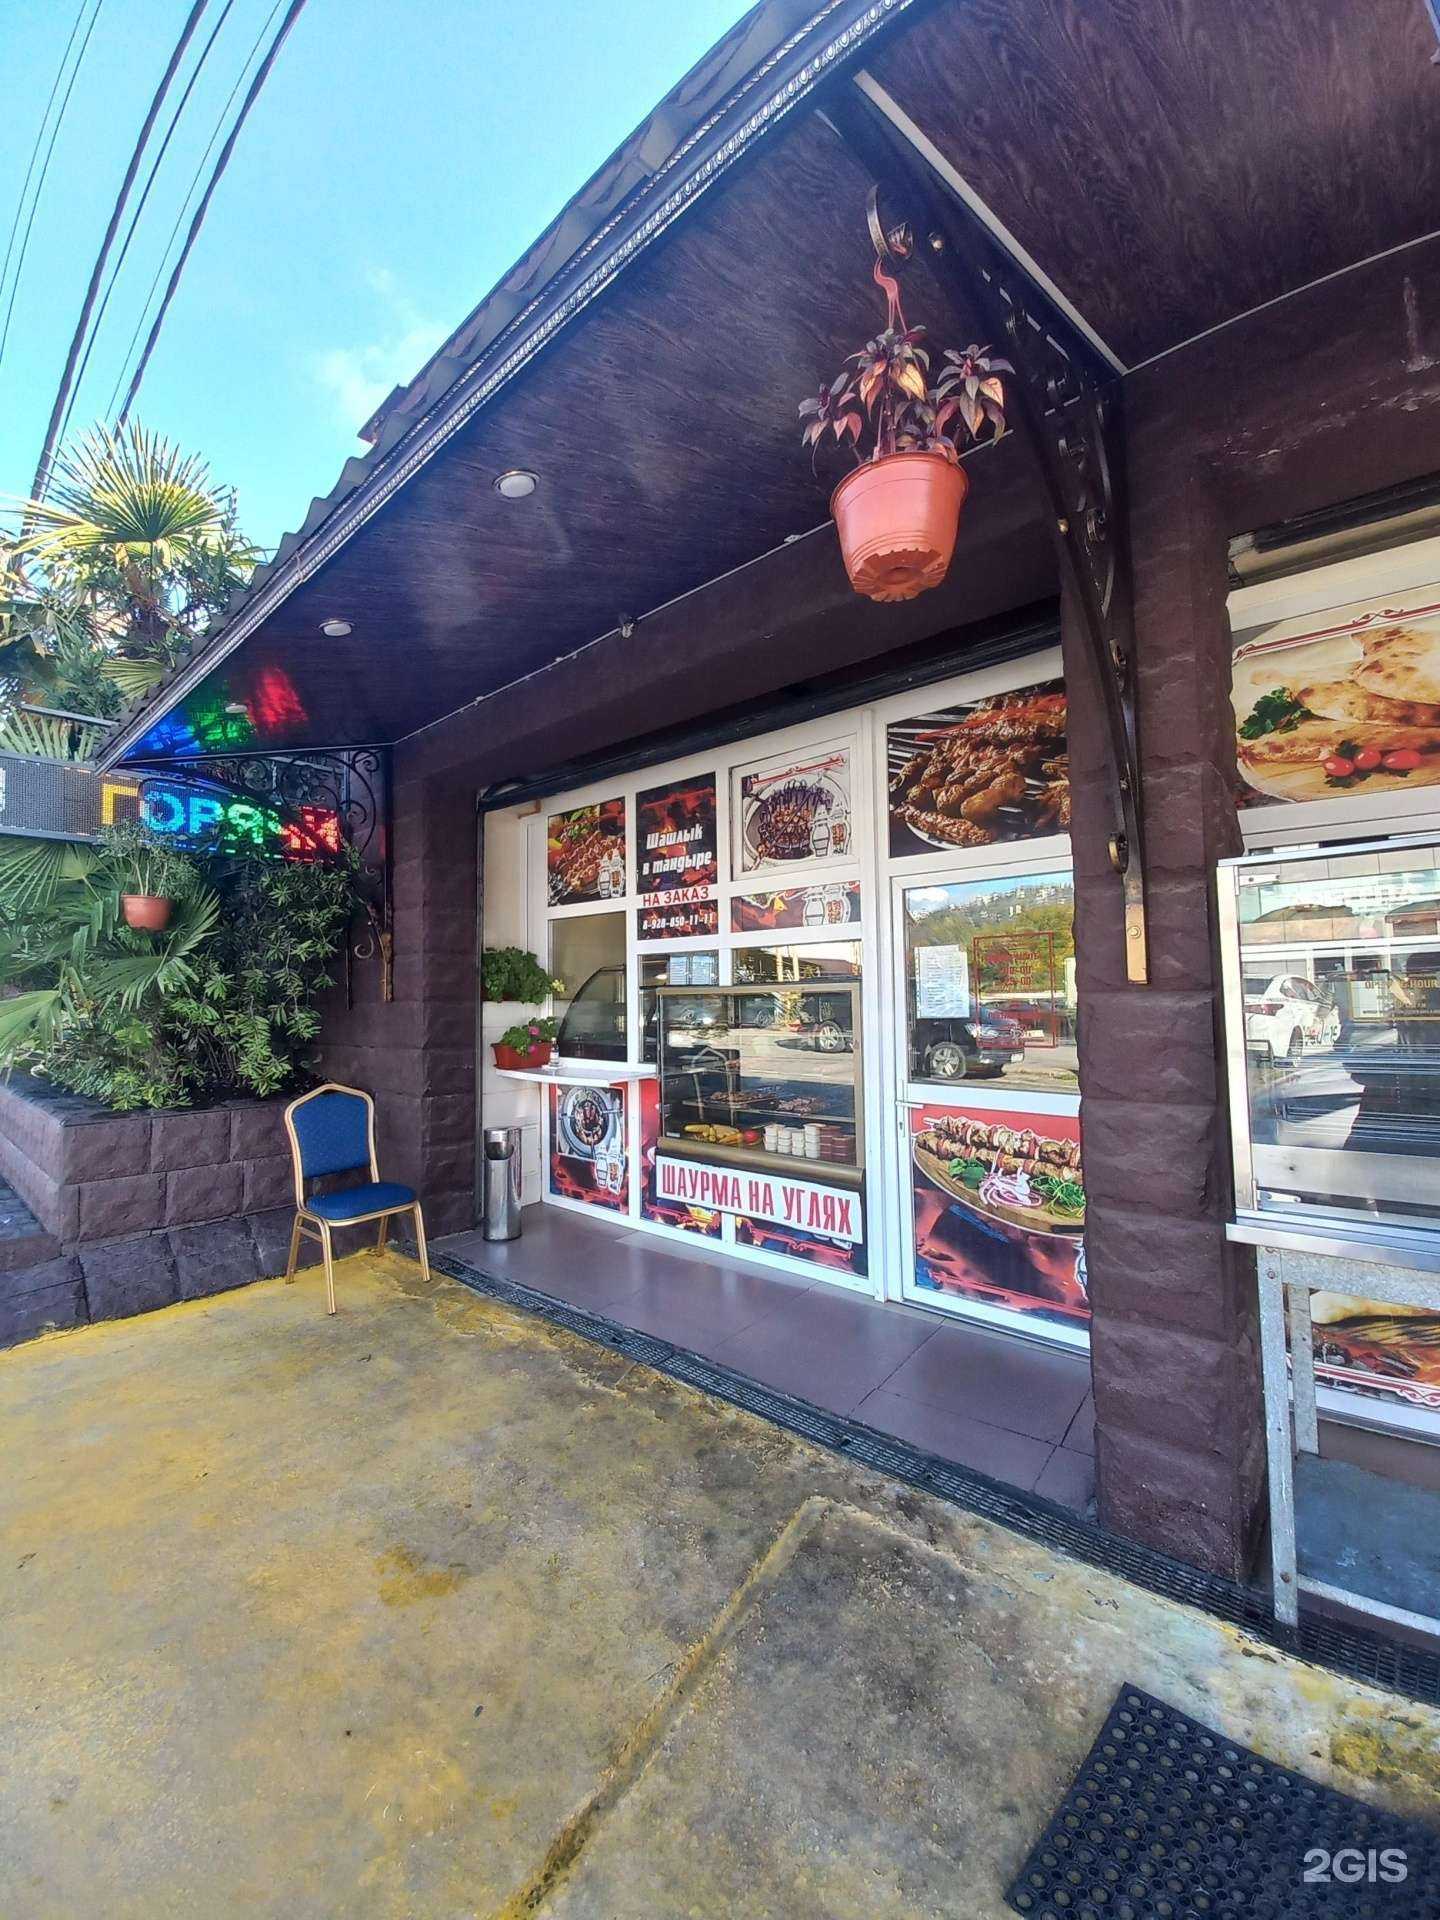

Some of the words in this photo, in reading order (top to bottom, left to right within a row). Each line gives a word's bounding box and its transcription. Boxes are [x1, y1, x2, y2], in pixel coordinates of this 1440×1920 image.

[646, 823, 703, 850] Шашлык
[642, 862, 650, 876] в
[653, 851, 712, 873] тандыре
[643, 893, 660, 907] НА
[664, 886, 709, 904] ЗАКАЗ
[662, 1163, 742, 1209] ШАУРМА
[749, 1179, 774, 1216] НА
[782, 1185, 851, 1235] УГЛЯХ
